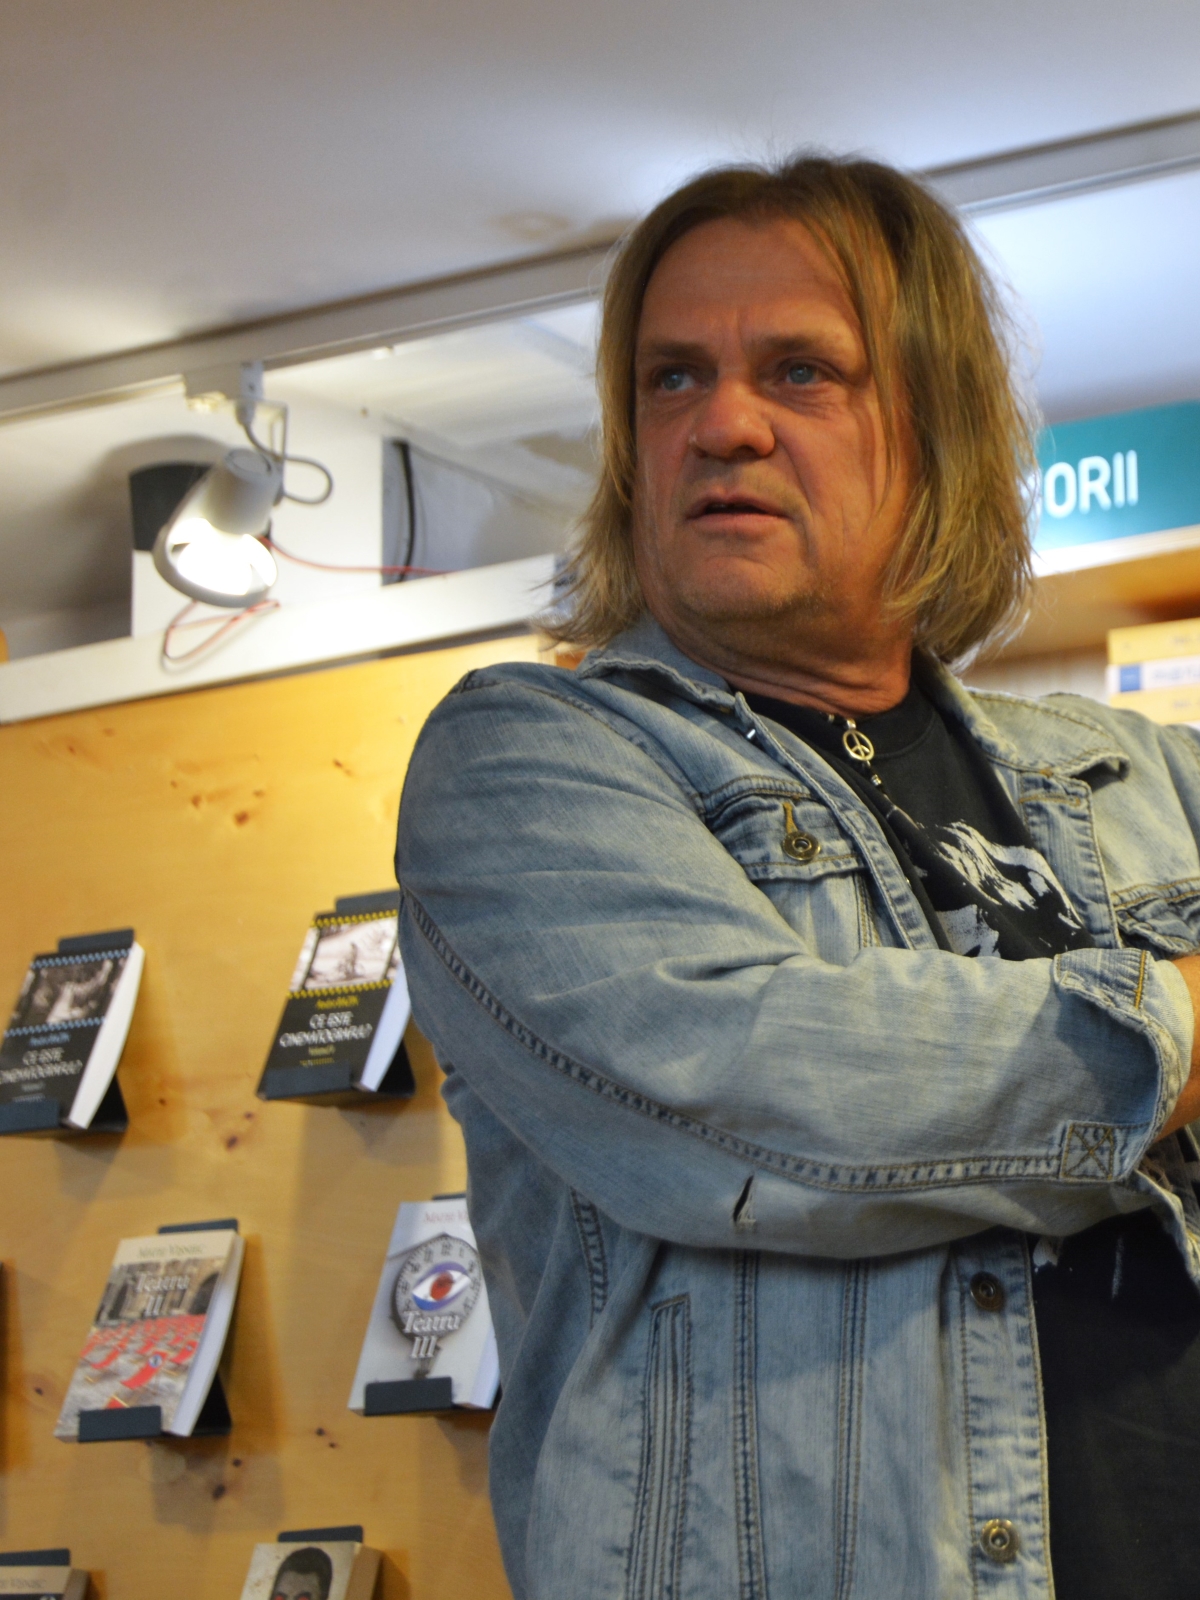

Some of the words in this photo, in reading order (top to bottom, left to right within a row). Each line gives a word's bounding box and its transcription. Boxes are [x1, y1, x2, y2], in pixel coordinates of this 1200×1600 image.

[1030, 449, 1139, 520] ORII
[136, 1271, 190, 1293] Teatru
[404, 1310, 461, 1334] Teatru
